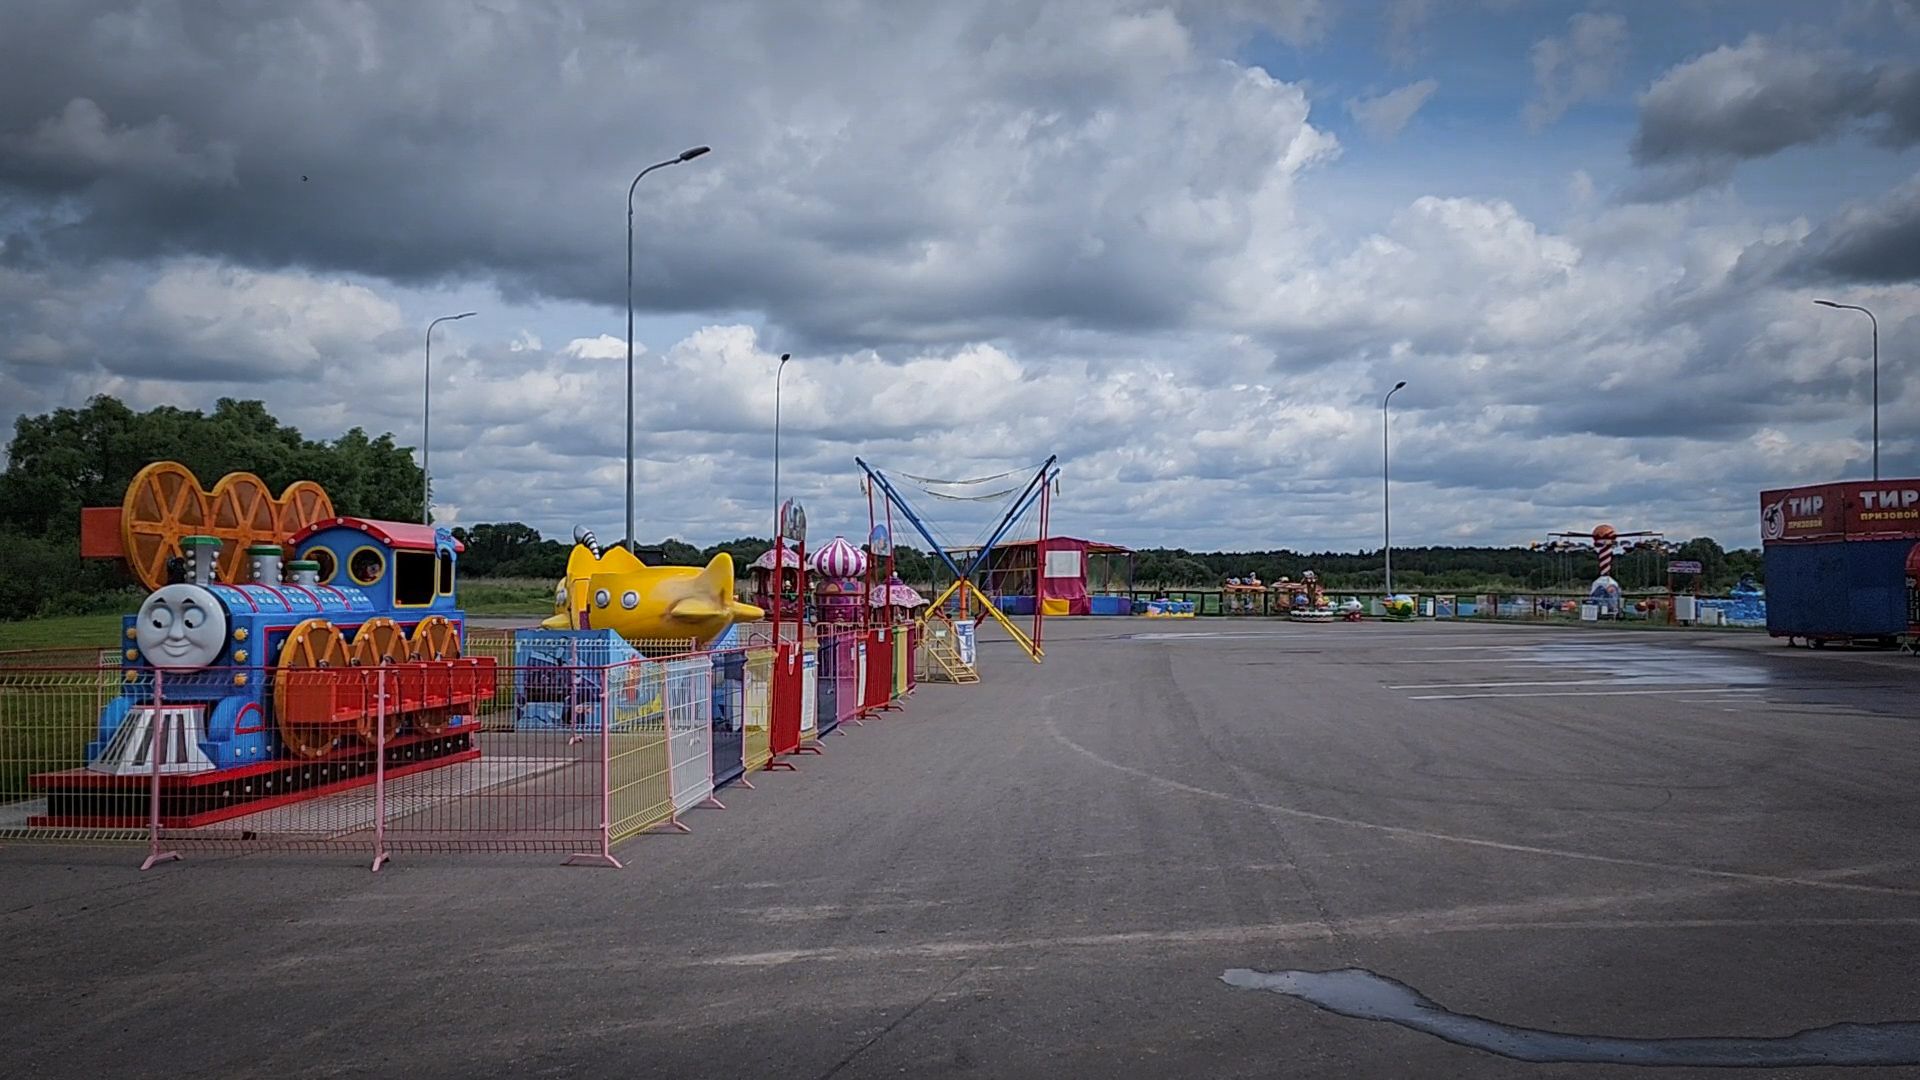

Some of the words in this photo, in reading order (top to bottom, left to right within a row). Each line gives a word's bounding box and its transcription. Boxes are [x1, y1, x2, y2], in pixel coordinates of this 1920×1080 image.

[1789, 495, 1823, 516] ТИР
[1859, 489, 1919, 509] ТИР
[1860, 509, 1919, 520] ПРИЗОВОЙ
[1788, 517, 1823, 529] ПРИЗОВОЙ
